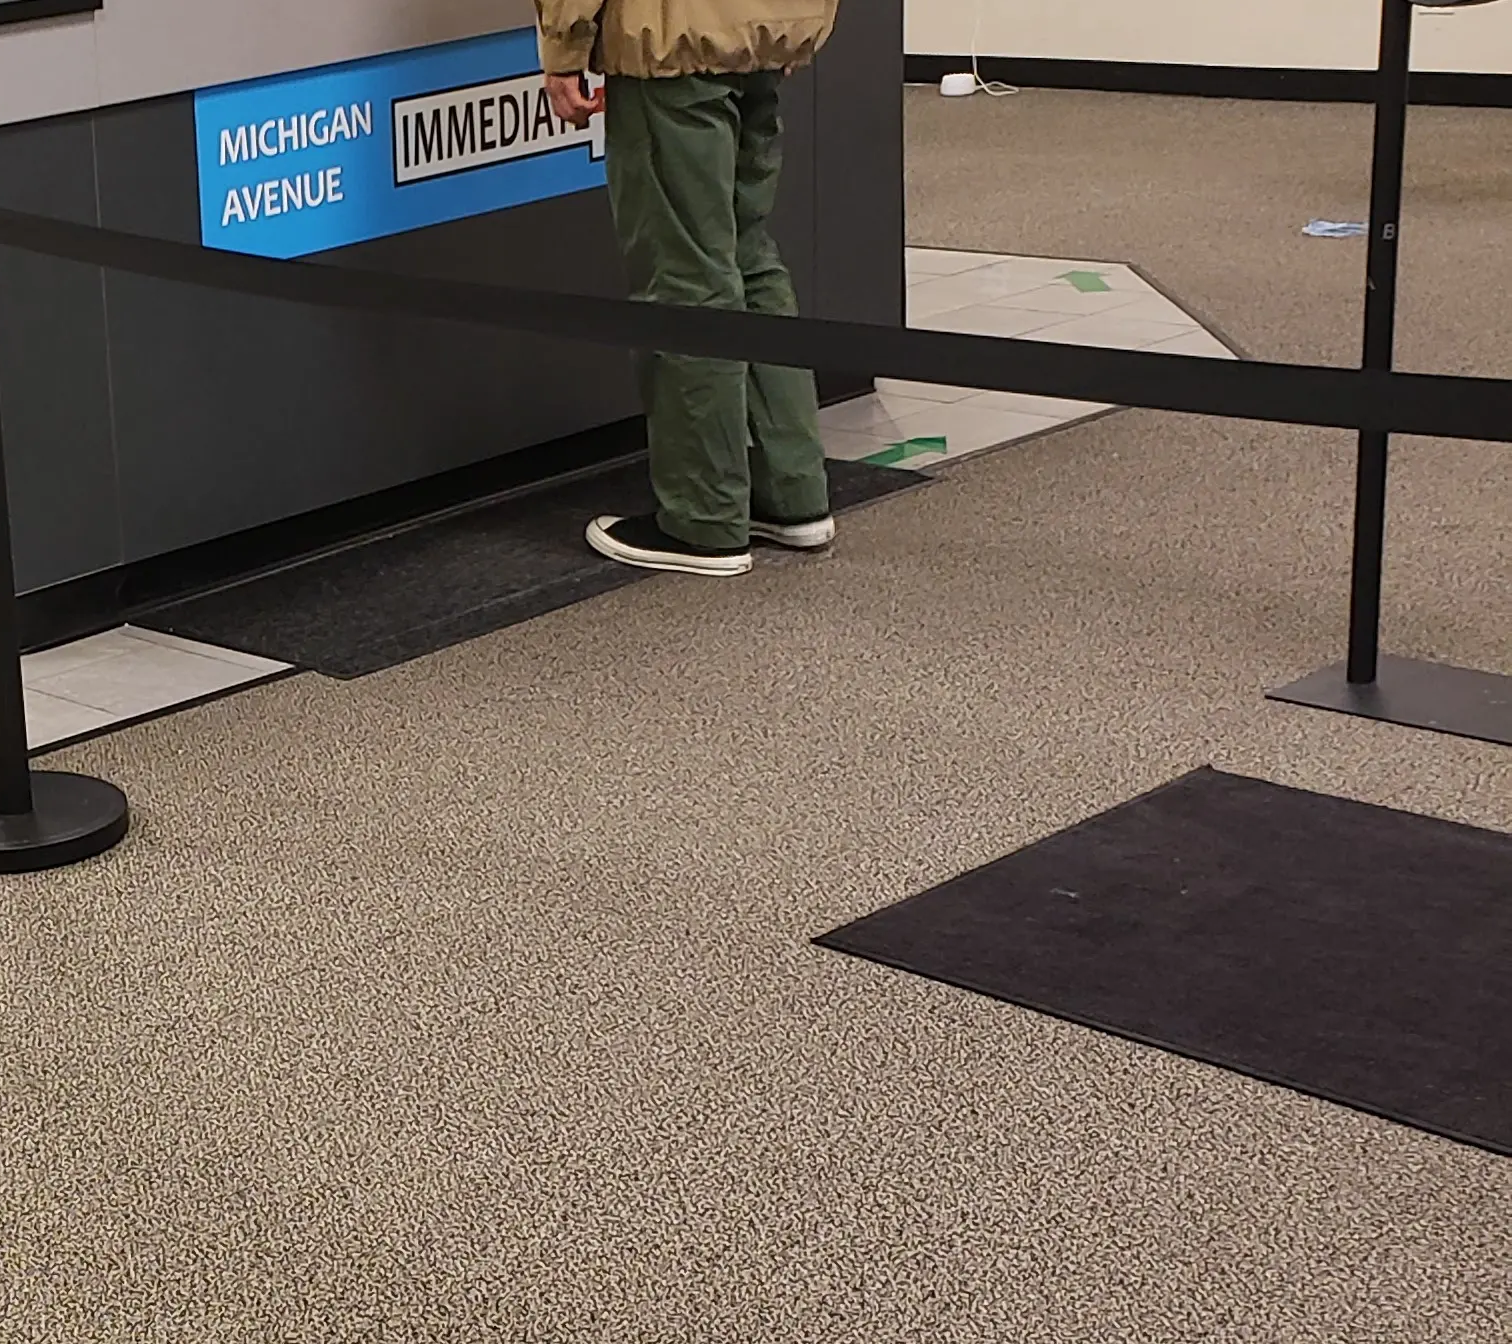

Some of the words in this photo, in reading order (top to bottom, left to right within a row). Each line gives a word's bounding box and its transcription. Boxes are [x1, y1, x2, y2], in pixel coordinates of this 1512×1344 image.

[219, 101, 372, 166] MICHIGAN
[402, 84, 590, 169] IMMEDIA
[222, 166, 344, 227] AVENUE
